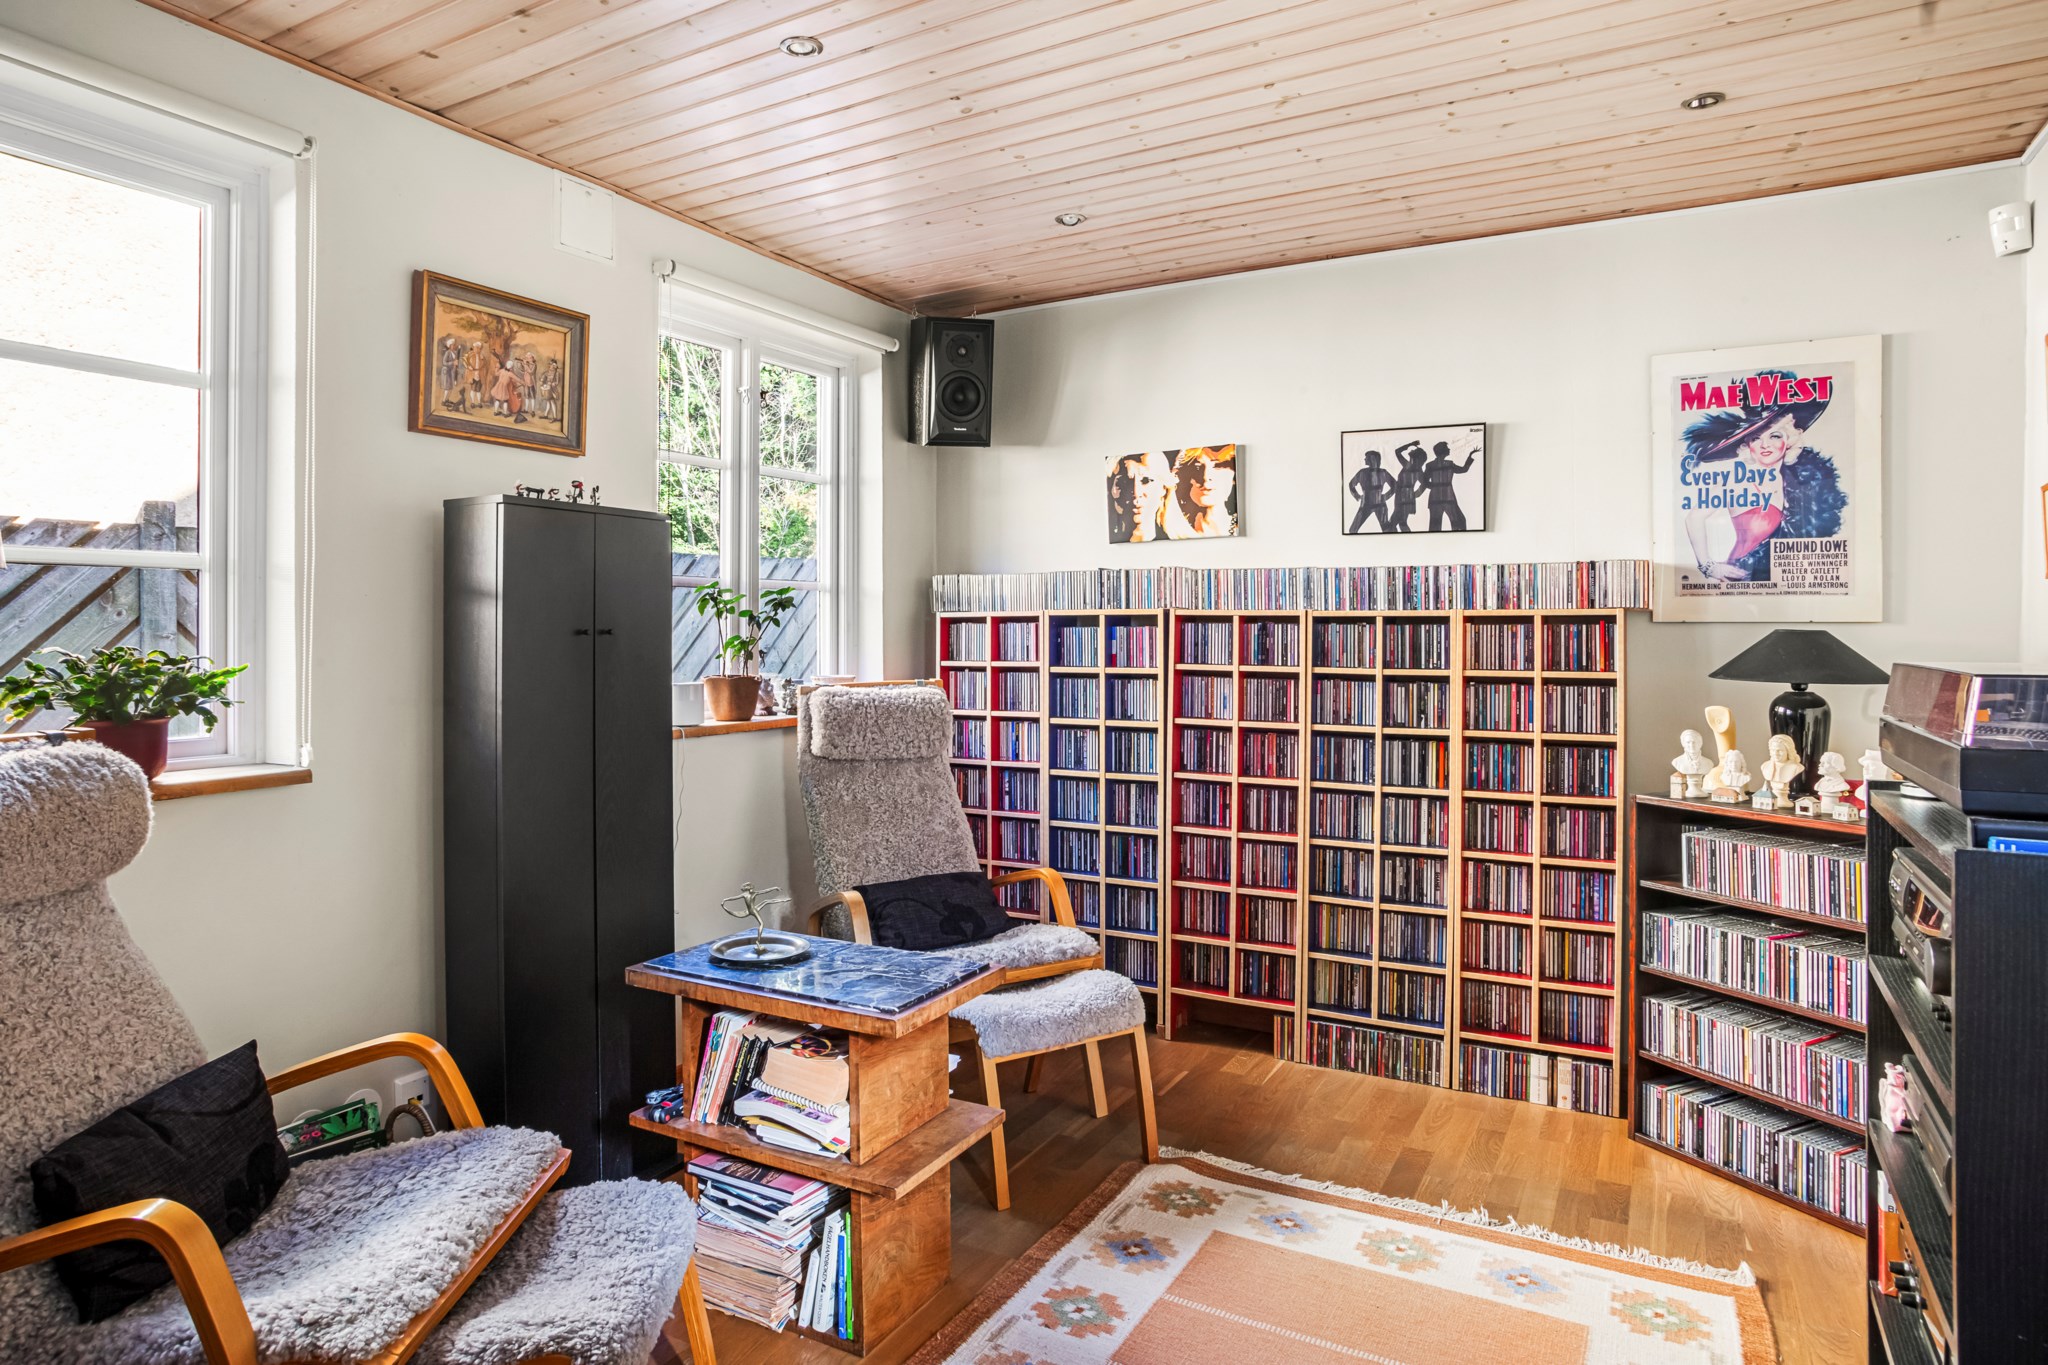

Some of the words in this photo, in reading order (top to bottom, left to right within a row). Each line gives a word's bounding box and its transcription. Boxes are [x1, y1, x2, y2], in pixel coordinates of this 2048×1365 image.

[1680, 381, 1743, 412] MAE
[1746, 374, 1833, 406] WEST
[1680, 455, 1730, 486] Every
[1734, 461, 1777, 486] Days
[1681, 496, 1692, 510] a
[1697, 487, 1773, 511] Holiday
[1773, 541, 1818, 554] EDMUND
[1820, 540, 1848, 553] LOWE
[1773, 553, 1801, 561] CHARLES
[1802, 552, 1848, 560] BUTTERWORTH
[1810, 567, 1840, 575] CATLETT
[1726, 582, 1751, 590] CHESTER
[1807, 581, 1849, 589] ARMSTRONG
[821, 1225, 833, 1282] FÅGELHANDBOKEN
